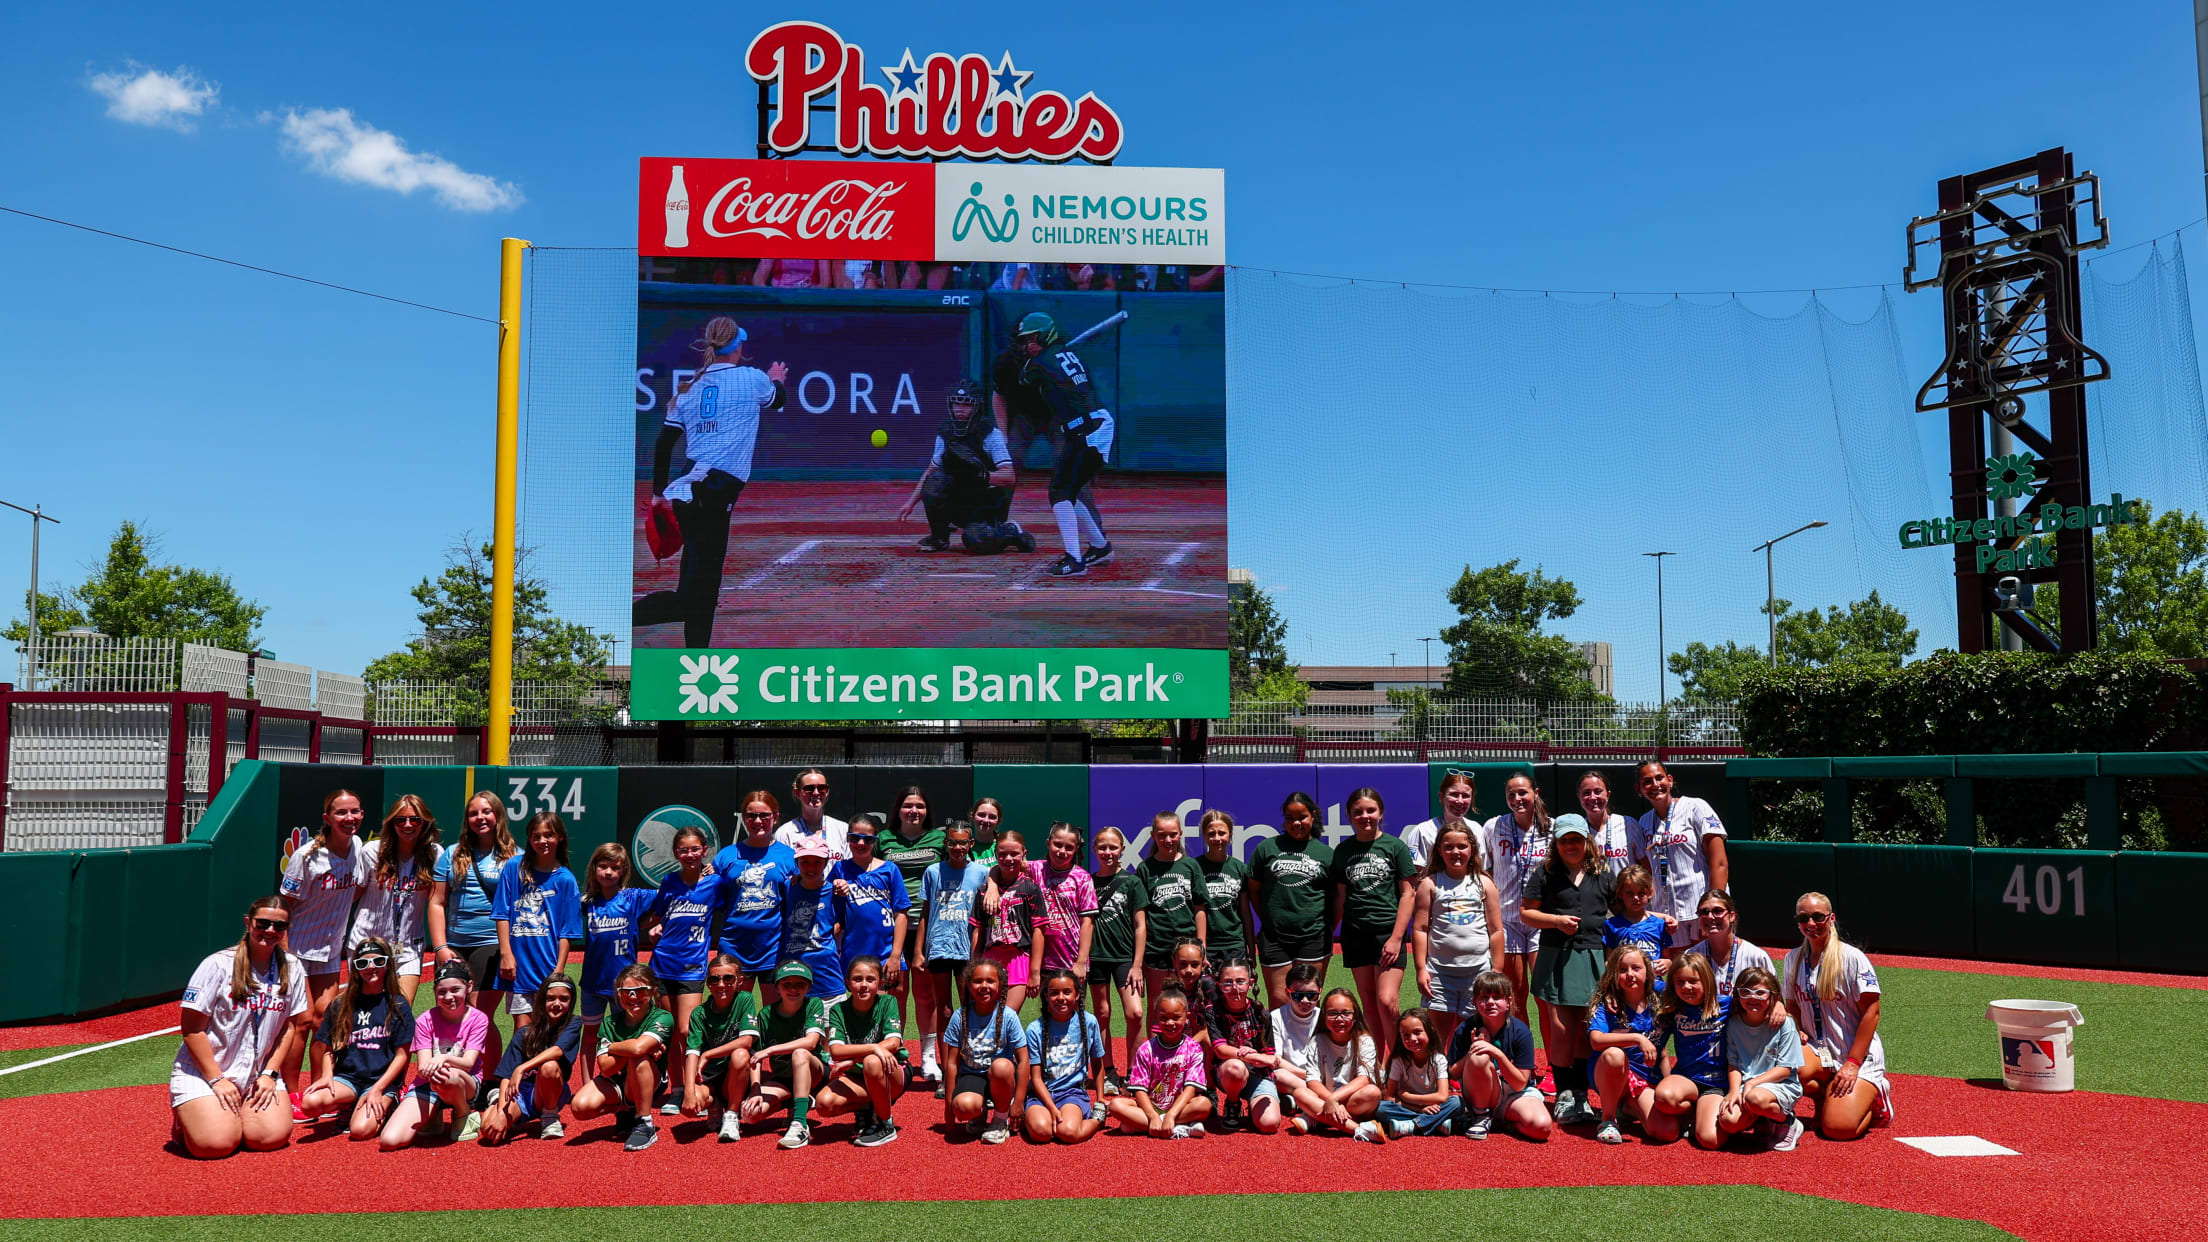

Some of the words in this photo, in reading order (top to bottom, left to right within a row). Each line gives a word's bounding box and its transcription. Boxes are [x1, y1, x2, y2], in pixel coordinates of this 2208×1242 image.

[745, 20, 1124, 160] Phillies
[703, 177, 907, 240] Coca-Cola
[1032, 195, 1208, 222] NEMOURS
[1032, 226, 1137, 245] CHILDREN'S
[1142, 228, 1208, 246] HEALTH
[942, 295, 970, 305] anc
[700, 385, 719, 419] 8
[1898, 513, 2034, 549] Citizens
[2040, 492, 2142, 534] Bank
[1976, 537, 2057, 574] Park
[758, 664, 940, 703] Citizens
[951, 662, 1062, 702] Bank
[506, 777, 586, 821] 334
[1270, 859, 1310, 875] Cougars
[1207, 885, 1232, 894] ougars
[2002, 864, 2086, 917] 401
[613, 938, 630, 956] 12
